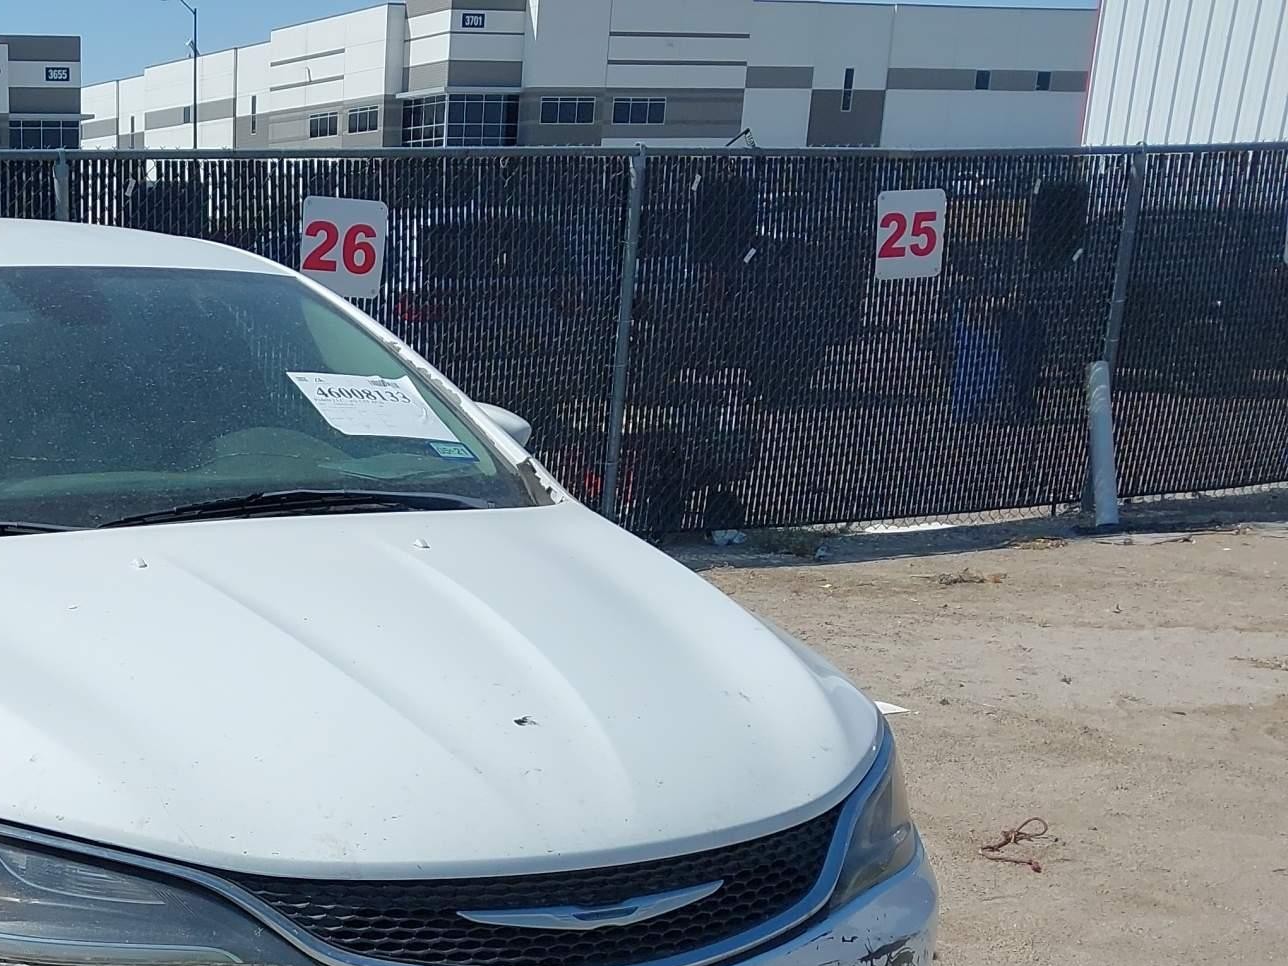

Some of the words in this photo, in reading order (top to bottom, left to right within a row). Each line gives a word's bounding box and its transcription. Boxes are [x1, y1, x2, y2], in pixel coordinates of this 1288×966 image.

[464, 15, 483, 26] 3701
[48, 68, 68, 80] 3655
[879, 212, 937, 258] 25
[303, 220, 375, 275] 26
[316, 386, 411, 404] 46008133
